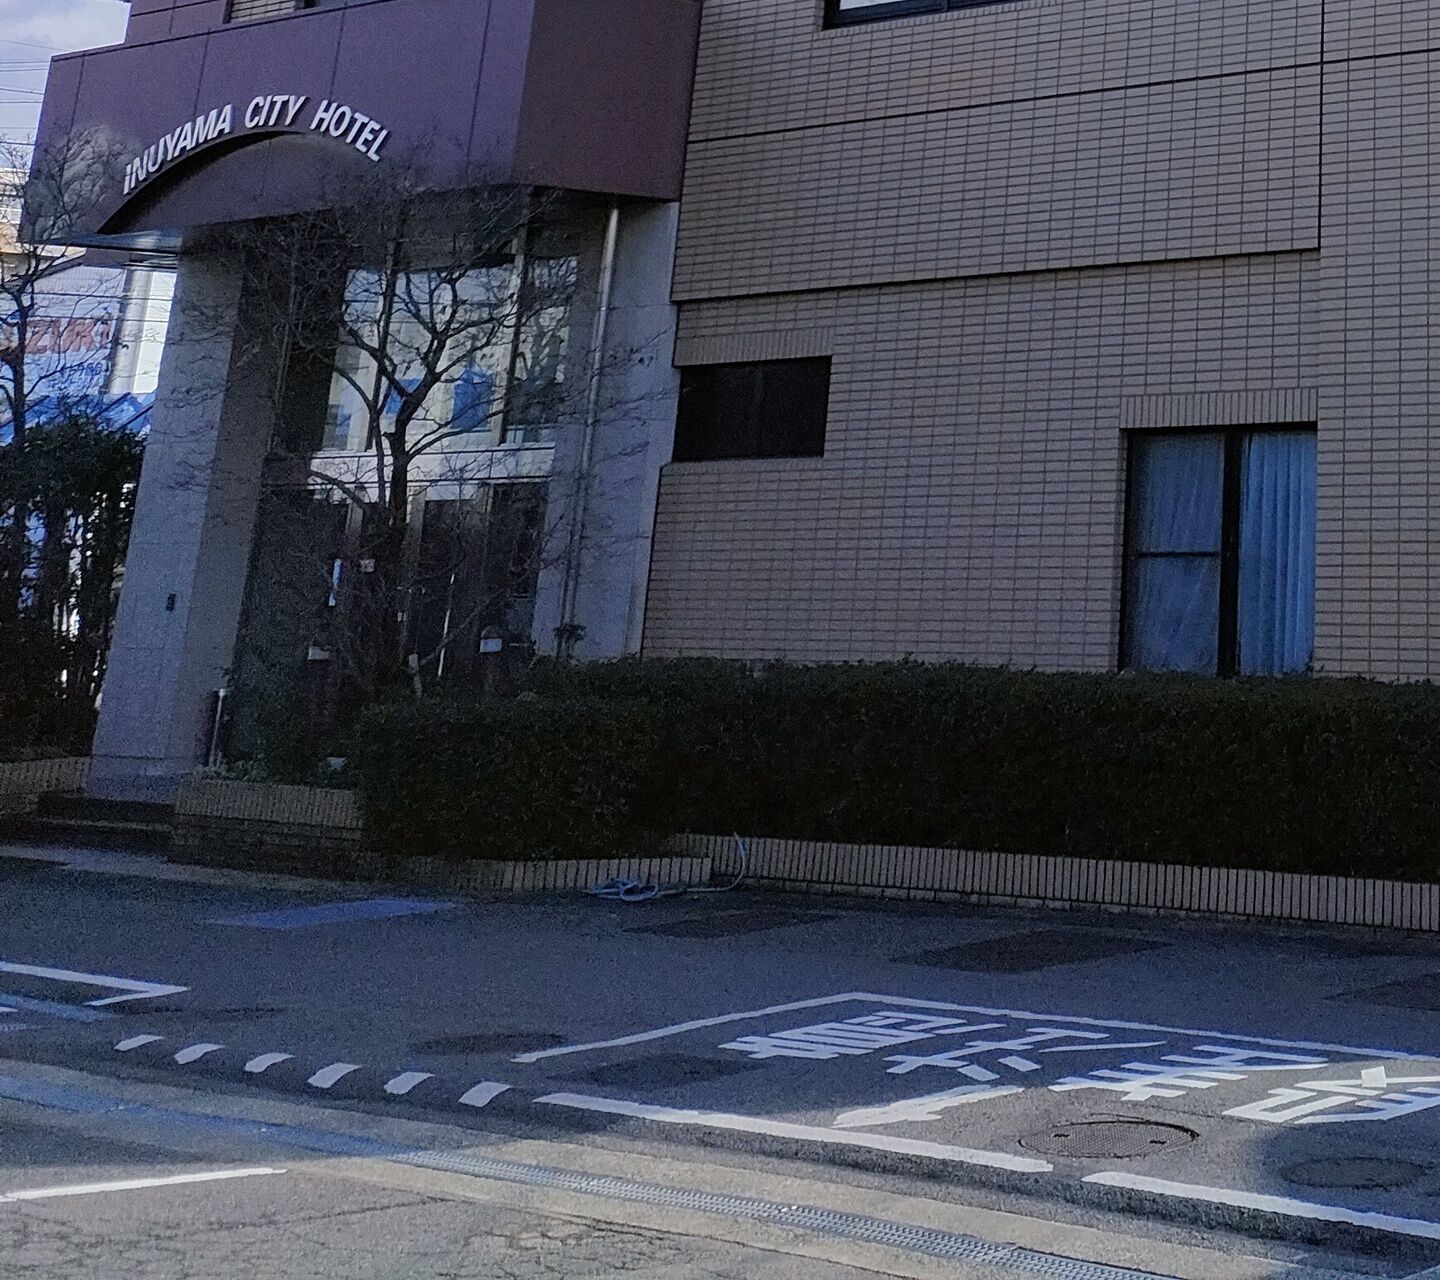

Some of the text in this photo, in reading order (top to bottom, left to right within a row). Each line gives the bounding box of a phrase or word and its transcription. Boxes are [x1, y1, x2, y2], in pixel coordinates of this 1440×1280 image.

[123, 95, 390, 195] INUYAMA CITY HOTEL
